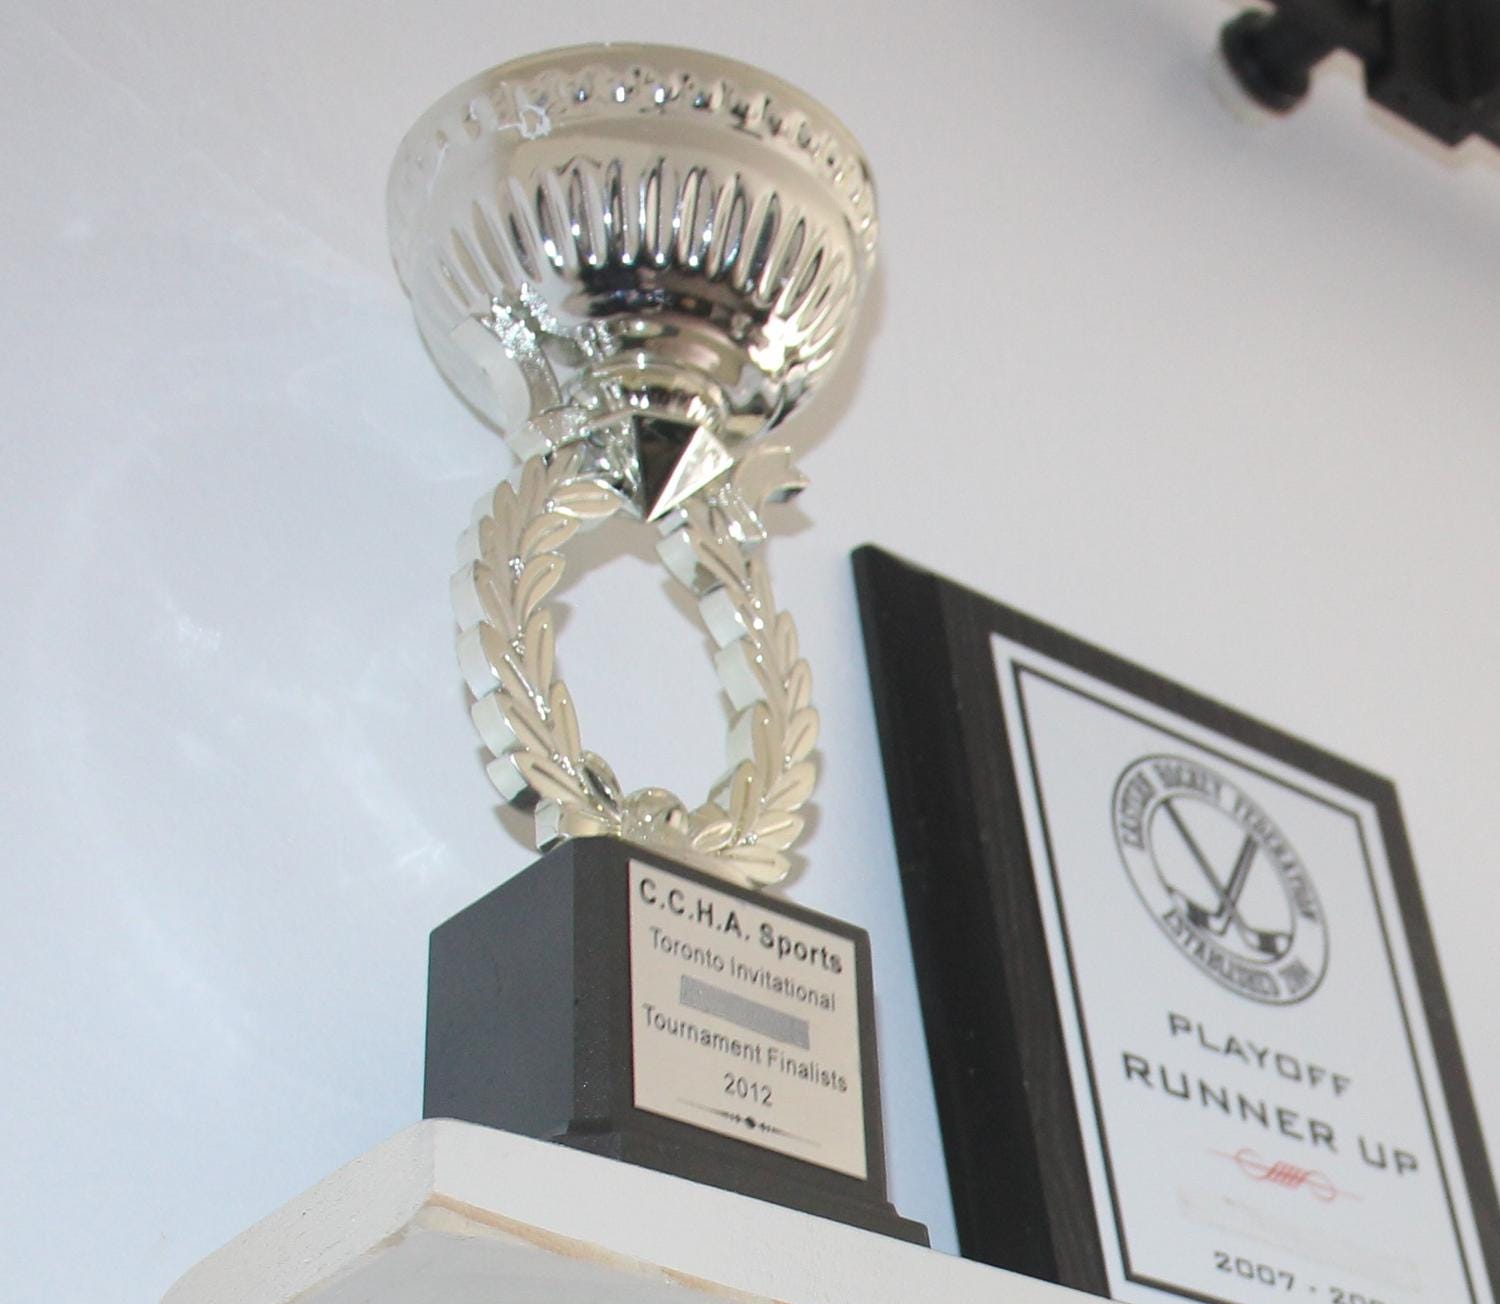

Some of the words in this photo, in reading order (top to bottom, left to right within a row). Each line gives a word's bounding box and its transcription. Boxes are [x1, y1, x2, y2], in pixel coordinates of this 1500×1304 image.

[638, 876, 751, 942] C.C.H.A.
[759, 921, 843, 975] Sports
[649, 926, 725, 973] Toronto
[731, 959, 836, 1012] Invitational
[641, 1004, 762, 1062] Tournament
[767, 1049, 848, 1093] Finalists
[723, 1072, 773, 1108] 2012
[1168, 1012, 1352, 1098] PLAYOFF
[1122, 1052, 1338, 1153] RUNNER
[1358, 1136, 1419, 1176] UP
[1213, 1251, 1296, 1293] 2007
